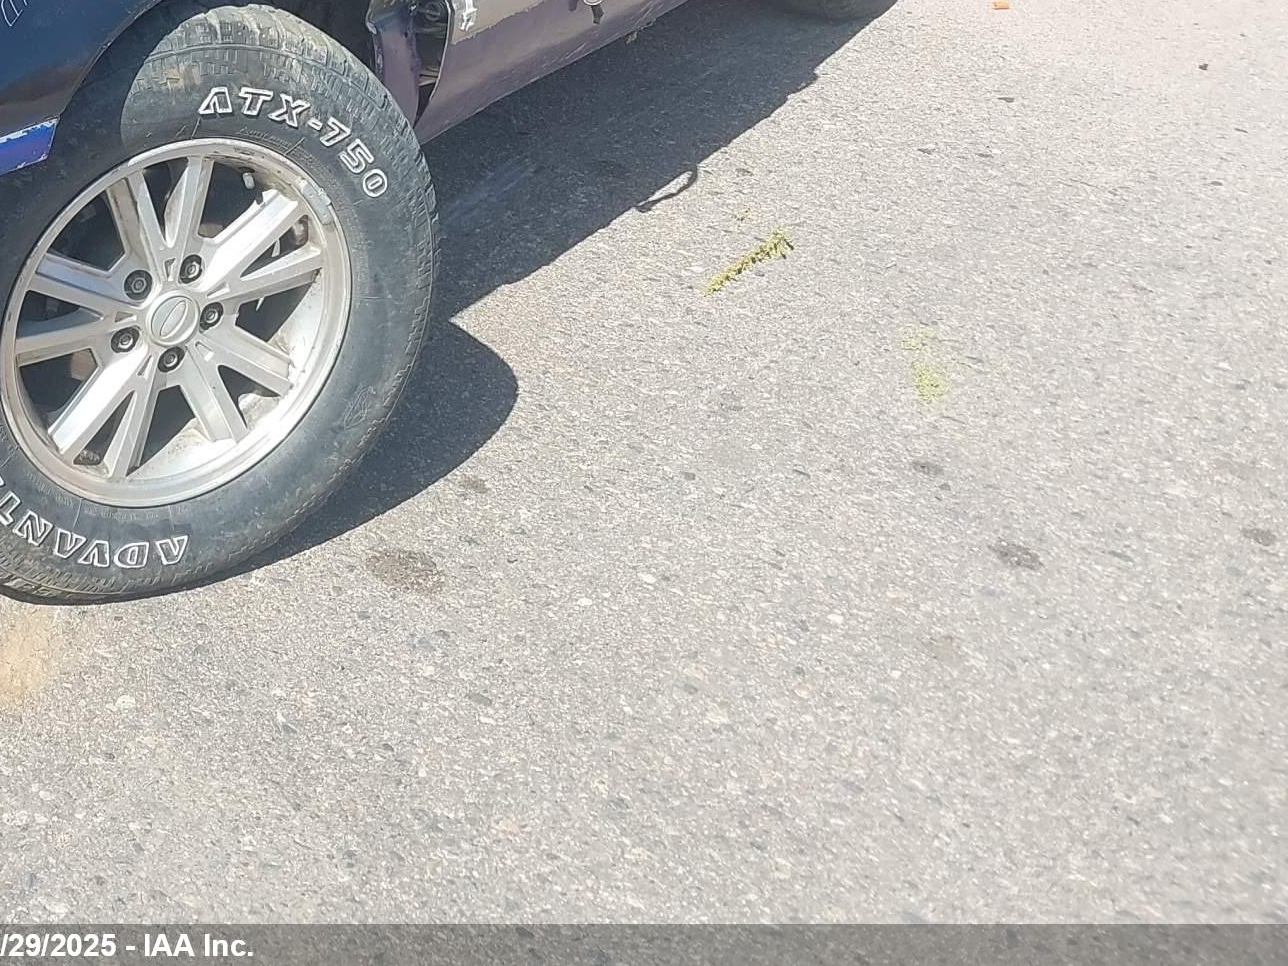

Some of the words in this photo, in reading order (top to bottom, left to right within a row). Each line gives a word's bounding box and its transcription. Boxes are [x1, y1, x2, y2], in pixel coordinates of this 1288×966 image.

[198, 86, 388, 198] ATX-750
[144, 933, 195, 956] IAA
[203, 933, 253, 956] Inc.
